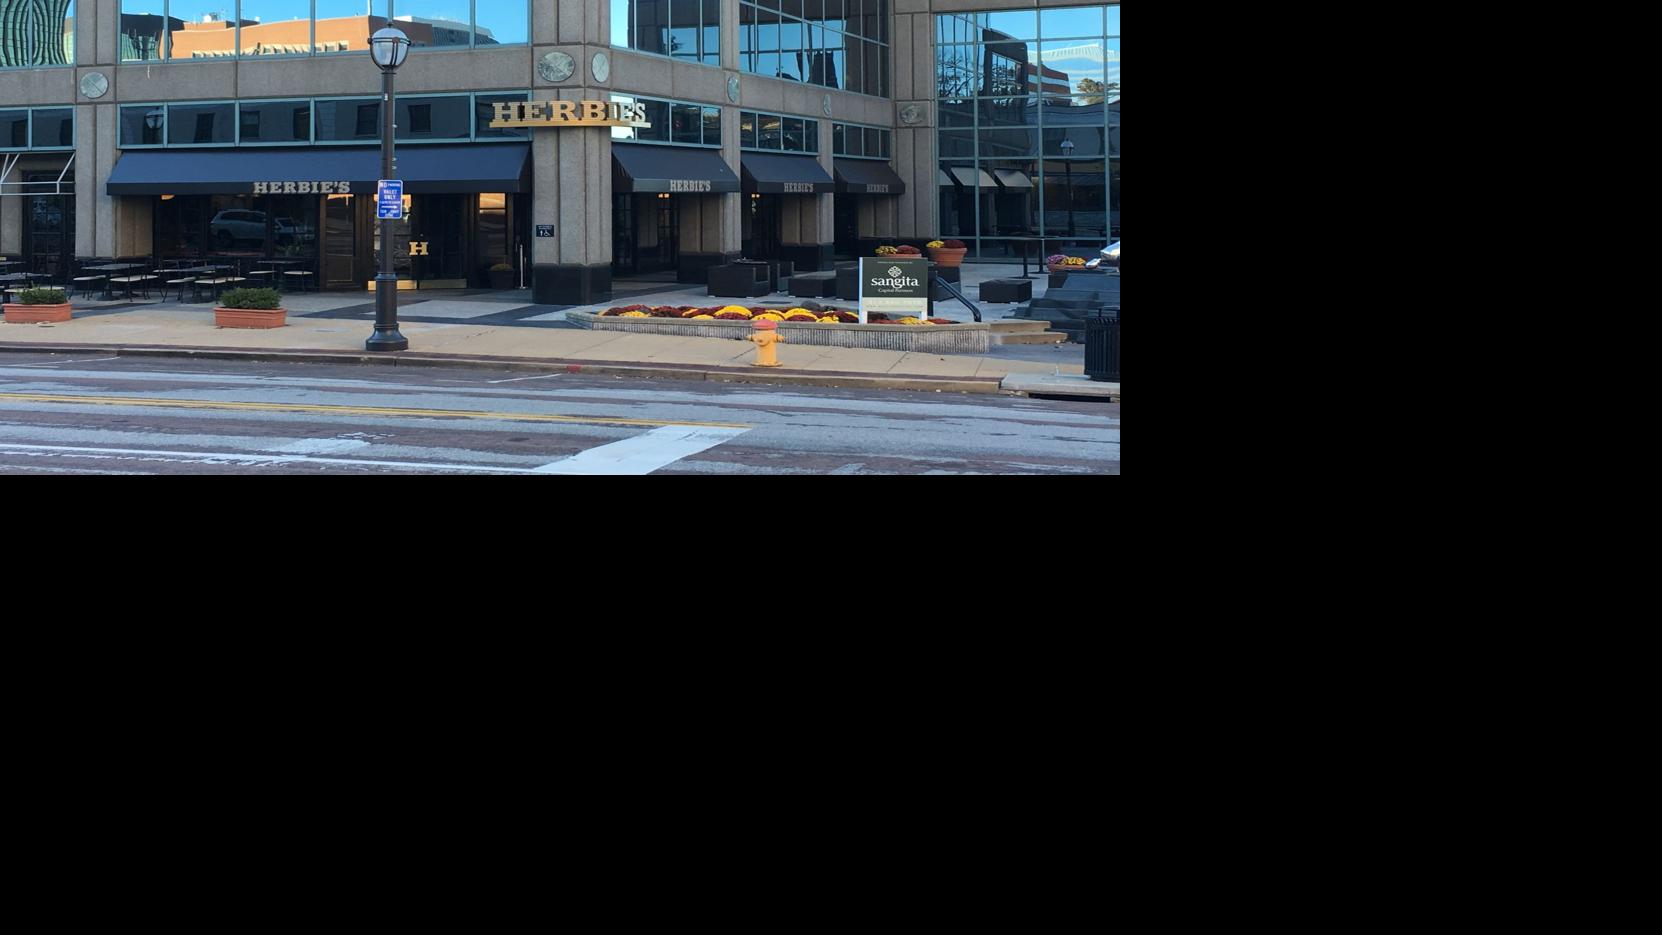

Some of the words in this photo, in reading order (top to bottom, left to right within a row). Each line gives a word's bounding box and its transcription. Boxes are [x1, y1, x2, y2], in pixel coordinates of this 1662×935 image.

[492, 100, 646, 123] HERBIE'S
[253, 181, 351, 194] HERBIE'S
[669, 180, 711, 192] HERBIE'S
[783, 182, 814, 193] HERBIE'S
[409, 241, 429, 256] H
[871, 276, 920, 289] sangita
